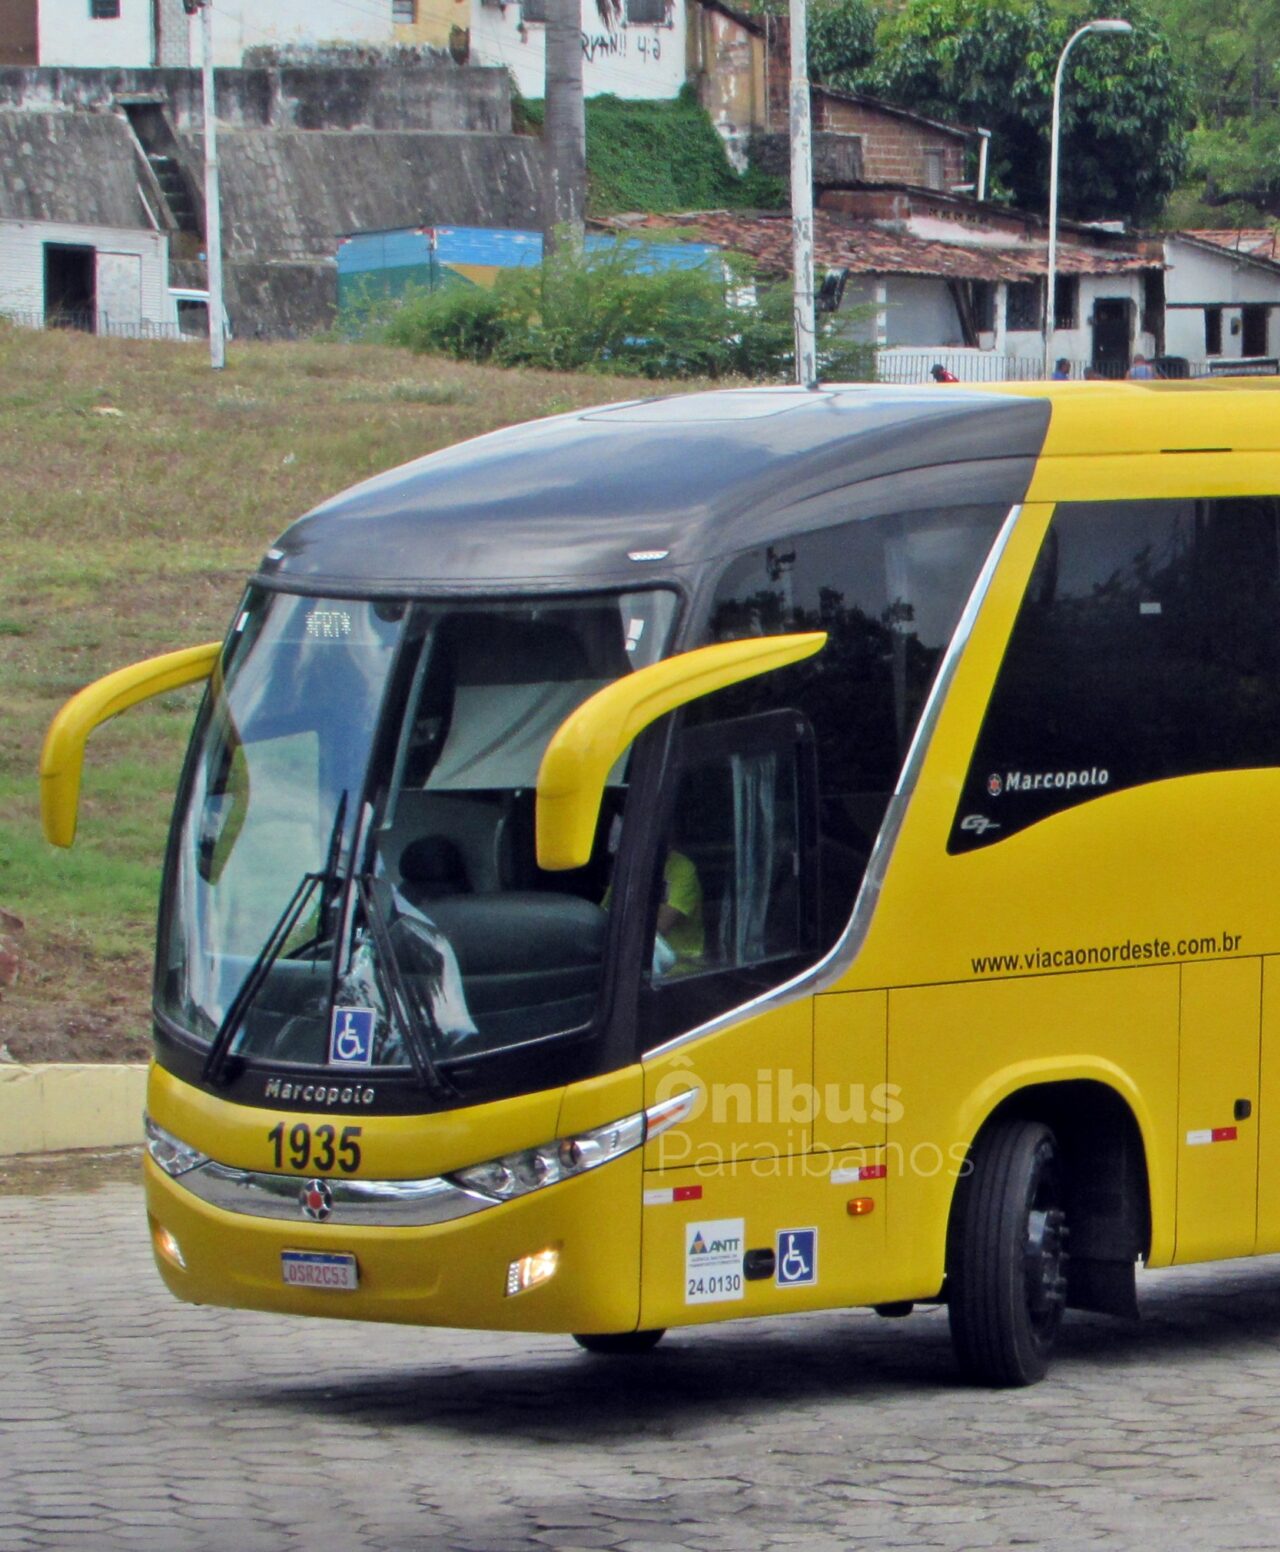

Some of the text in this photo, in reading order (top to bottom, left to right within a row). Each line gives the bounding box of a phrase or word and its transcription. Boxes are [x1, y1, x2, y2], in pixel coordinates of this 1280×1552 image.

[1005, 767, 1109, 792] Marcopolo
[972, 932, 1242, 974] www.viacaonordeste.com.br
[265, 1079, 374, 1105] Marcopolo
[267, 1121, 363, 1173] 1935
[708, 1238, 740, 1252] ANTT
[688, 1274, 741, 1296] 24.0130
